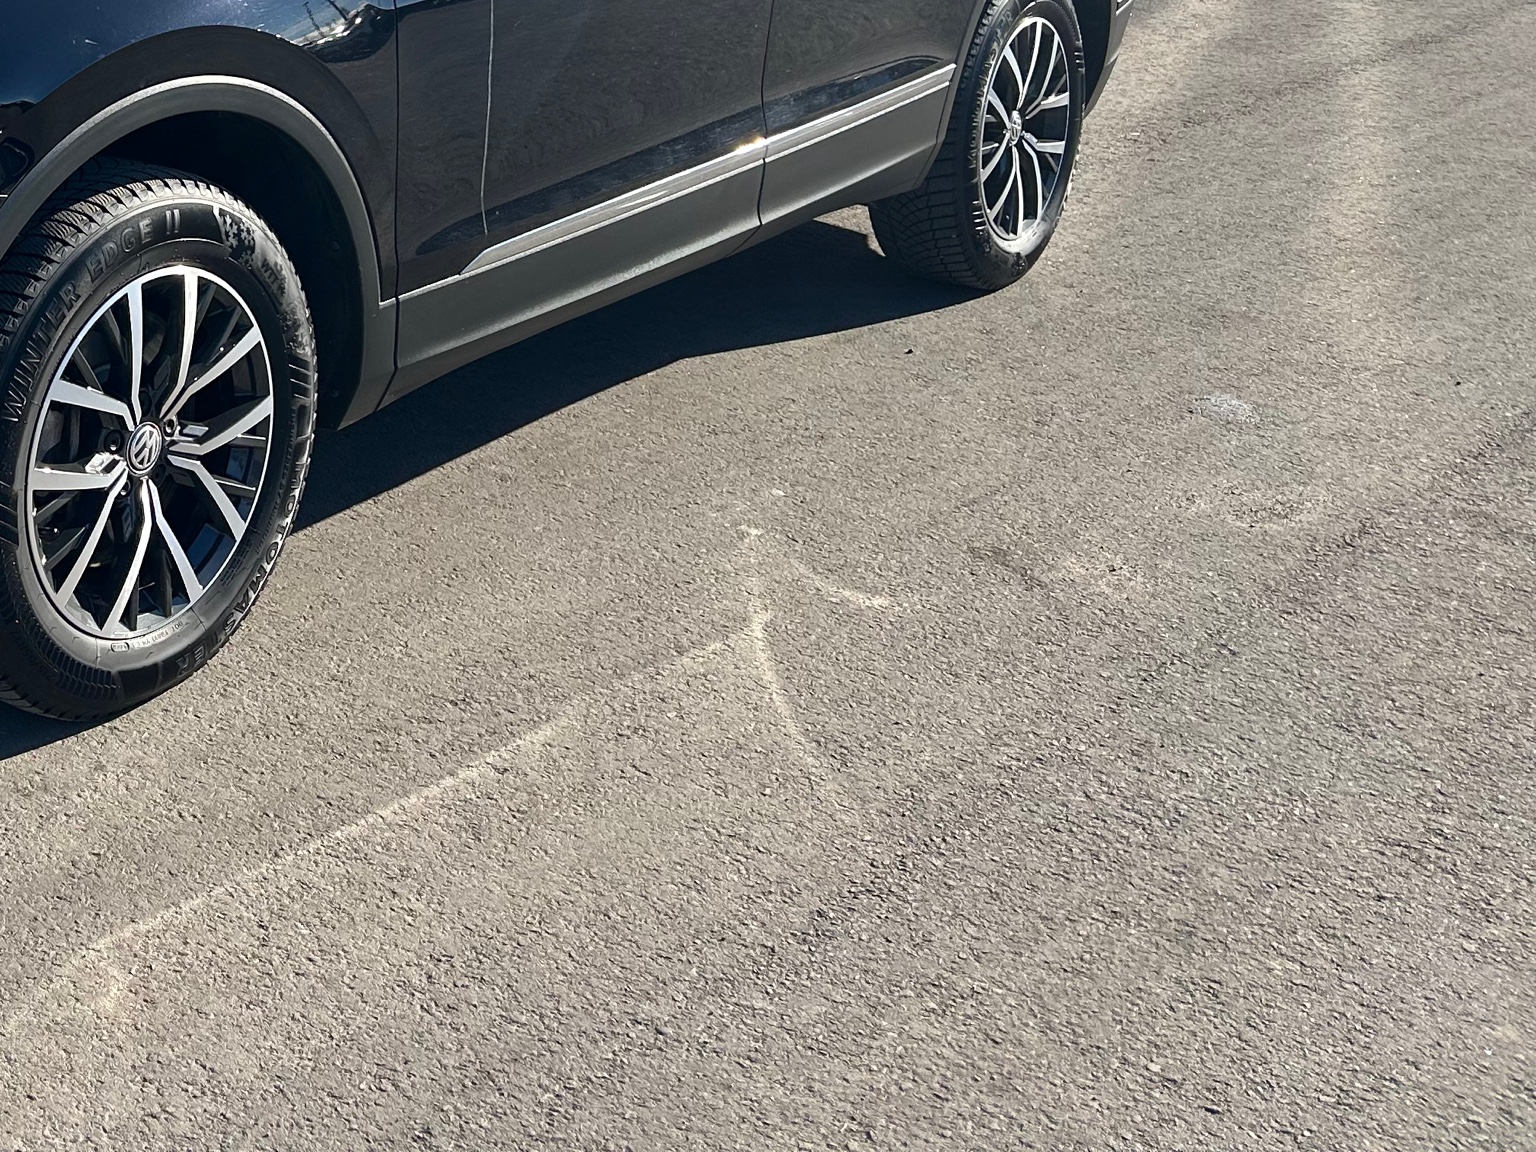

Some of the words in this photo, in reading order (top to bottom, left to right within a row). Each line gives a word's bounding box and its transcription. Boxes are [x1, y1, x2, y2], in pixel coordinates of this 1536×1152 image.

[2, 280, 81, 422] WINTER
[84, 217, 153, 284] EDGE
[175, 461, 309, 679] MOTOMASTER
